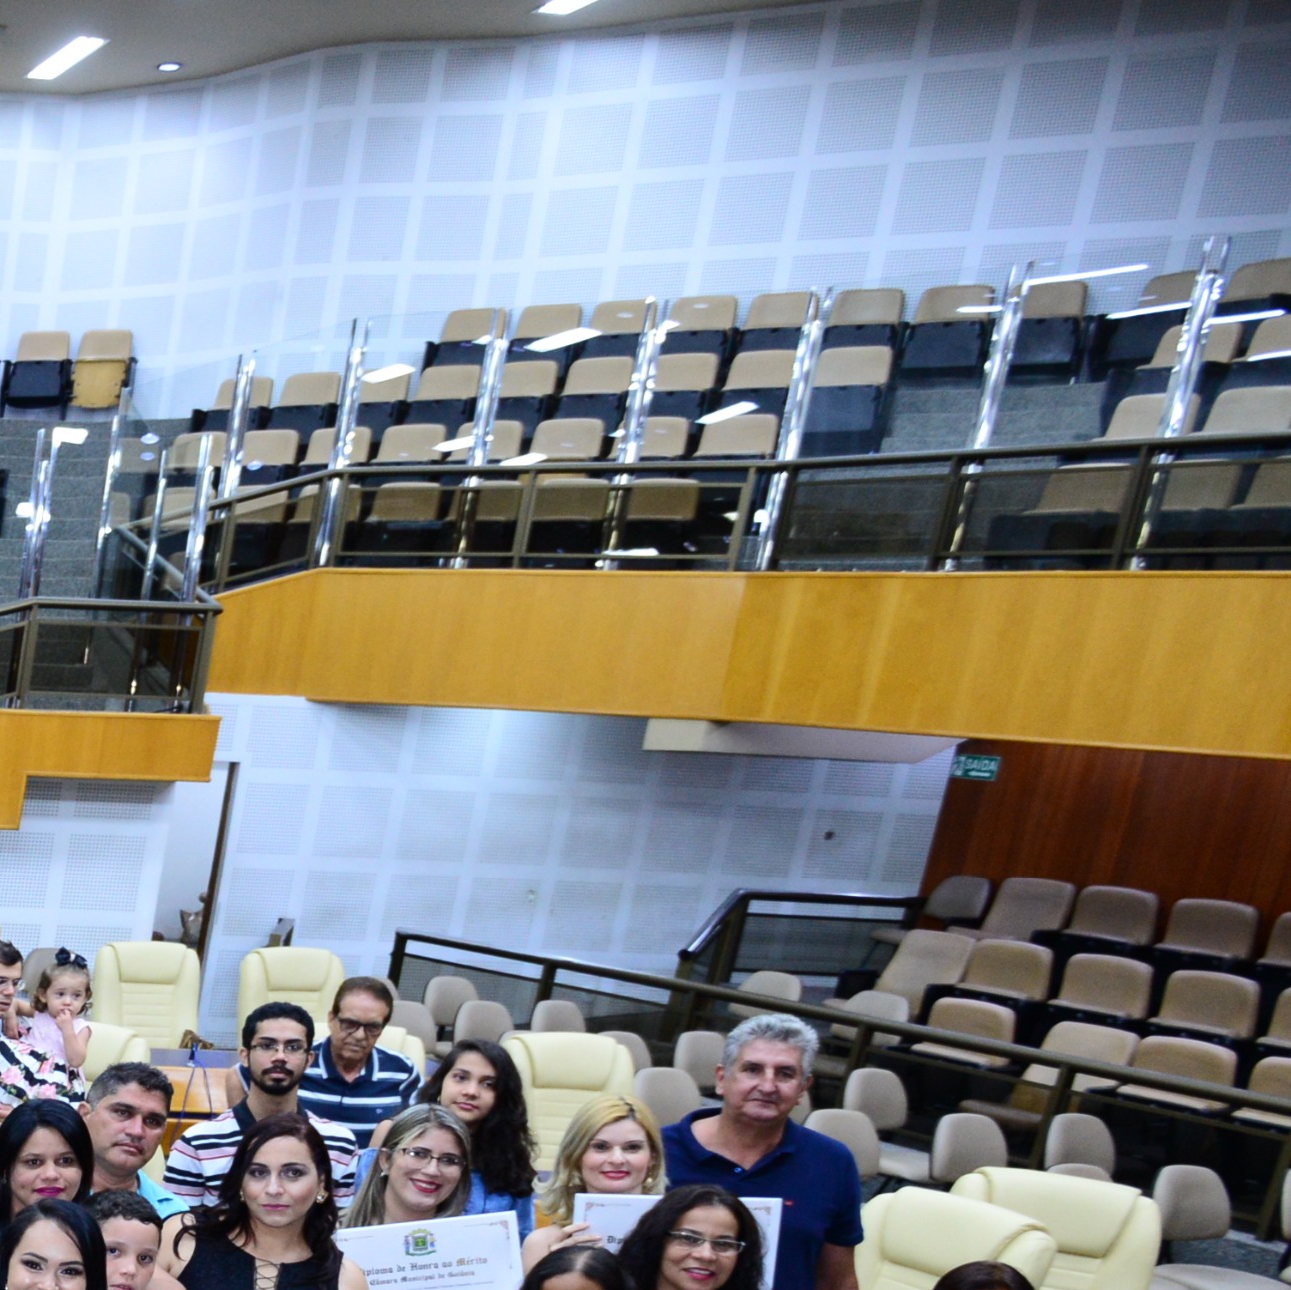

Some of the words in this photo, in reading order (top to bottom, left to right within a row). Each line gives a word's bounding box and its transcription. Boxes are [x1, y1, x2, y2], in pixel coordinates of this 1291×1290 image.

[396, 1264, 406, 1272] de
[409, 1262, 439, 1271] Honra
[455, 1257, 487, 1266] Mérito
